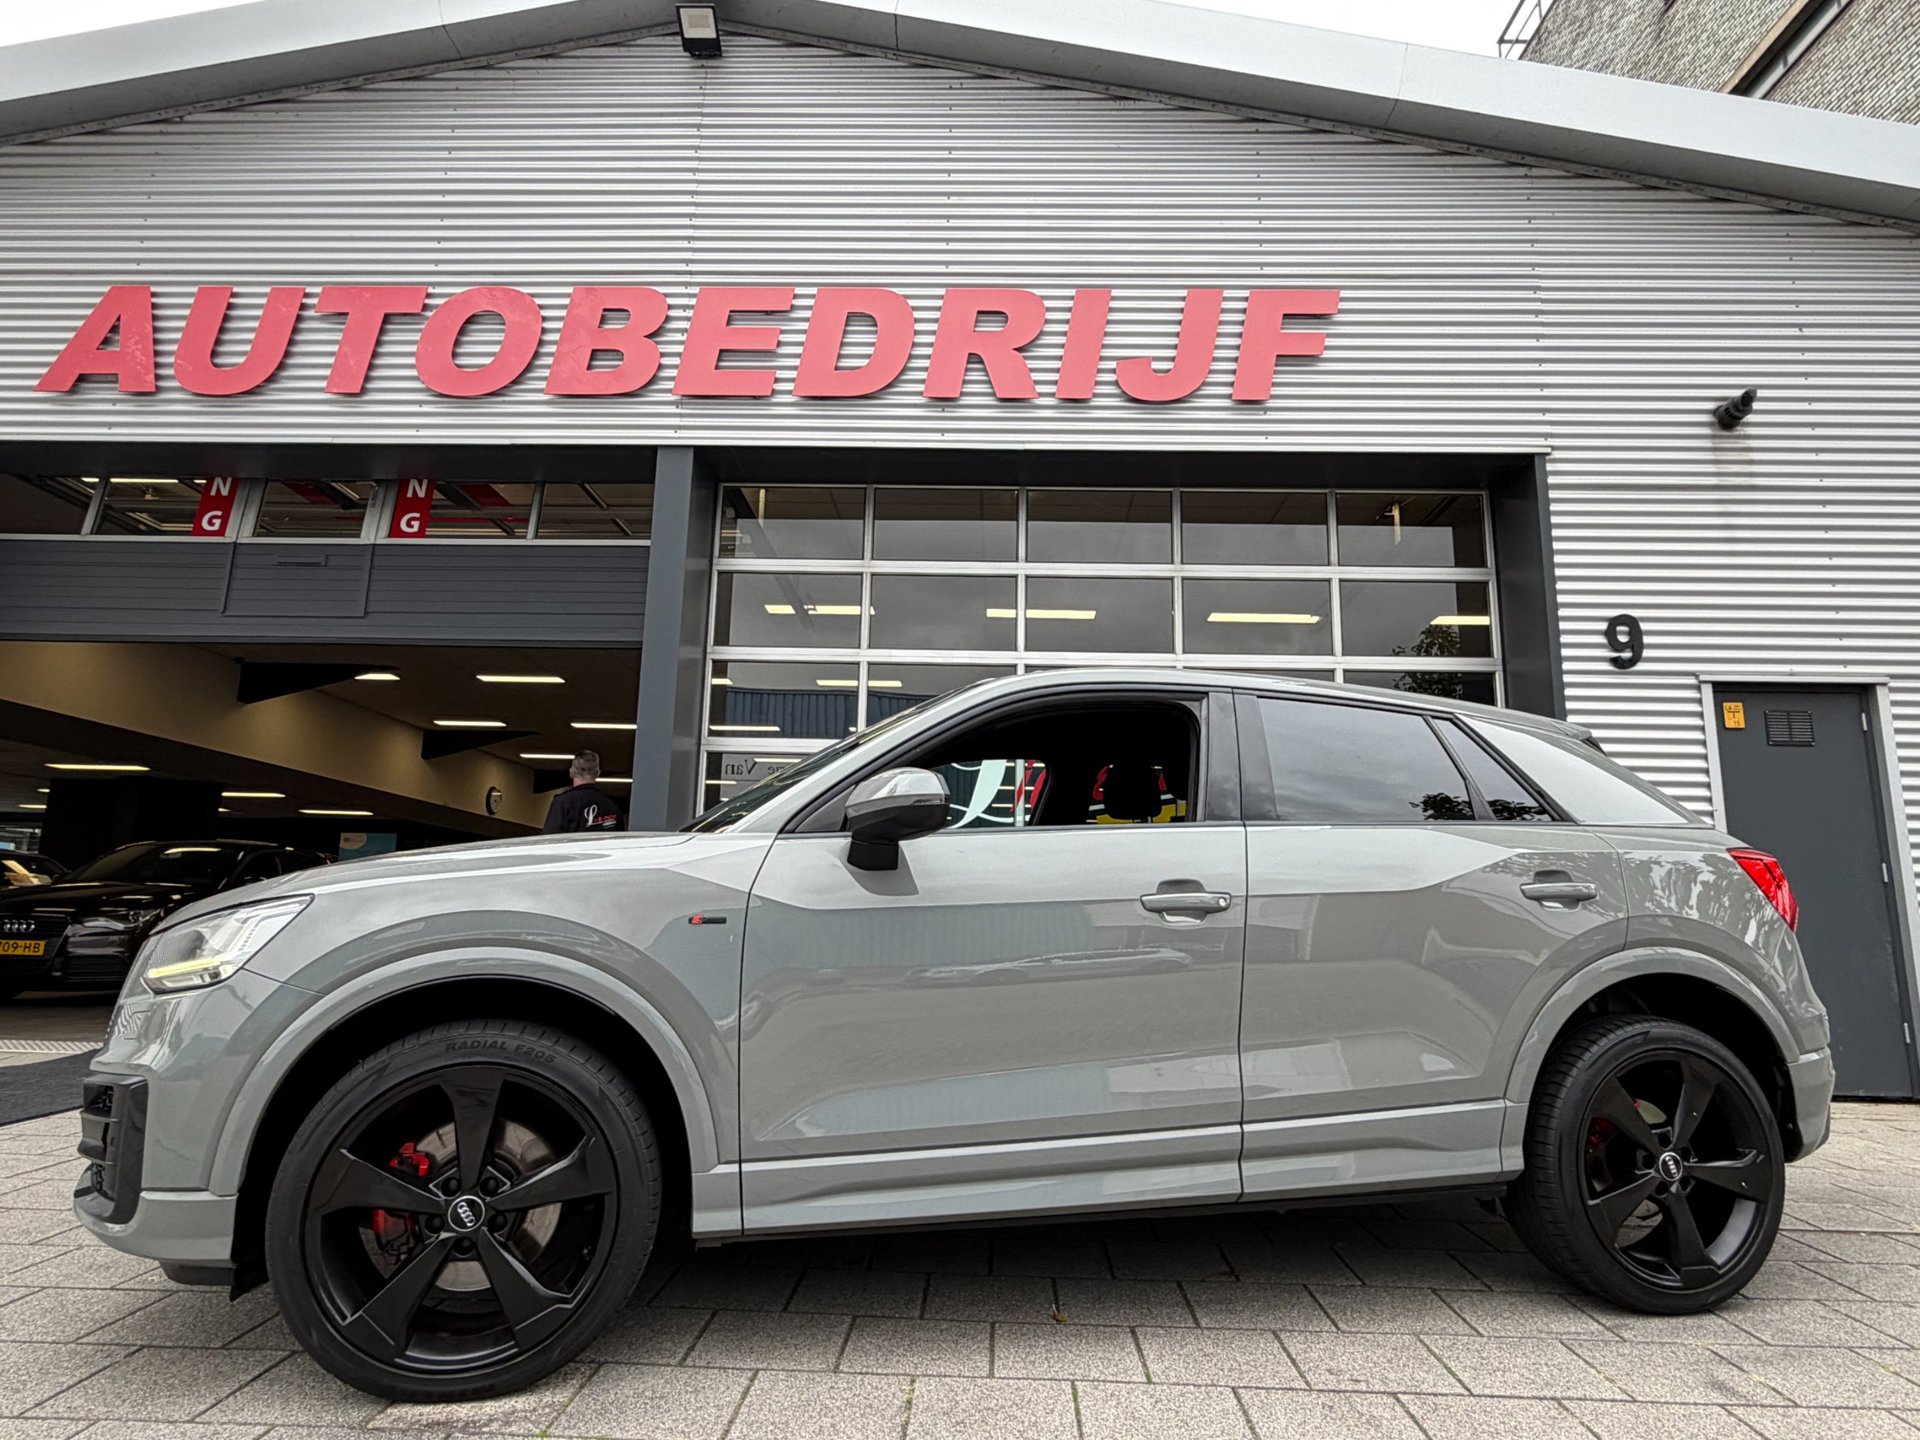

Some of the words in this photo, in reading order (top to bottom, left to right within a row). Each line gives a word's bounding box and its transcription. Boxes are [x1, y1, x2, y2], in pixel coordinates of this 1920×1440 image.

[33, 284, 1340, 402] AUTOBEDRIJF
[1604, 614, 1644, 670] 9
[445, 1039, 508, 1052] RADIAL
